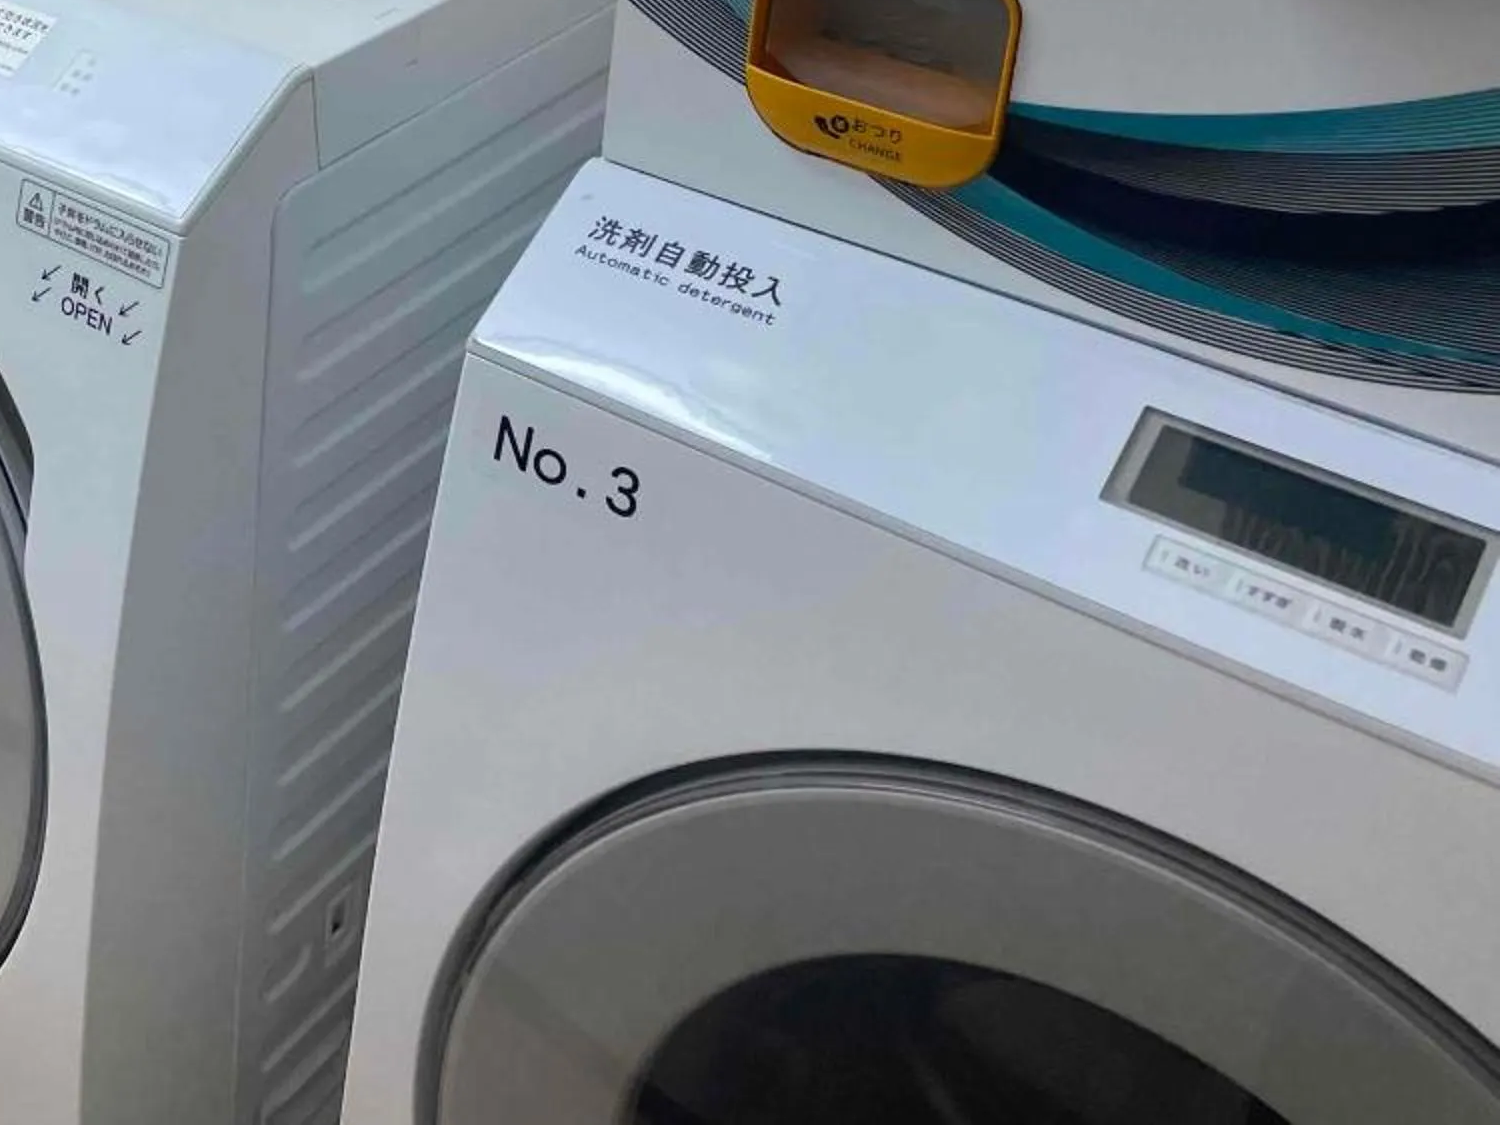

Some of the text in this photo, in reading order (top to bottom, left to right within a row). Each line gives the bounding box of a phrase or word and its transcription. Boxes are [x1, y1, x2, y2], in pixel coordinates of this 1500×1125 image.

[848, 139, 904, 163] CHANGE
[850, 117, 904, 146] おつり
[587, 215, 783, 307] 洗剤自動投入
[70, 272, 105, 305] 開く
[574, 244, 777, 326] Automatic detergent
[61, 296, 113, 336] OPEN
[493, 415, 641, 518] No.3
